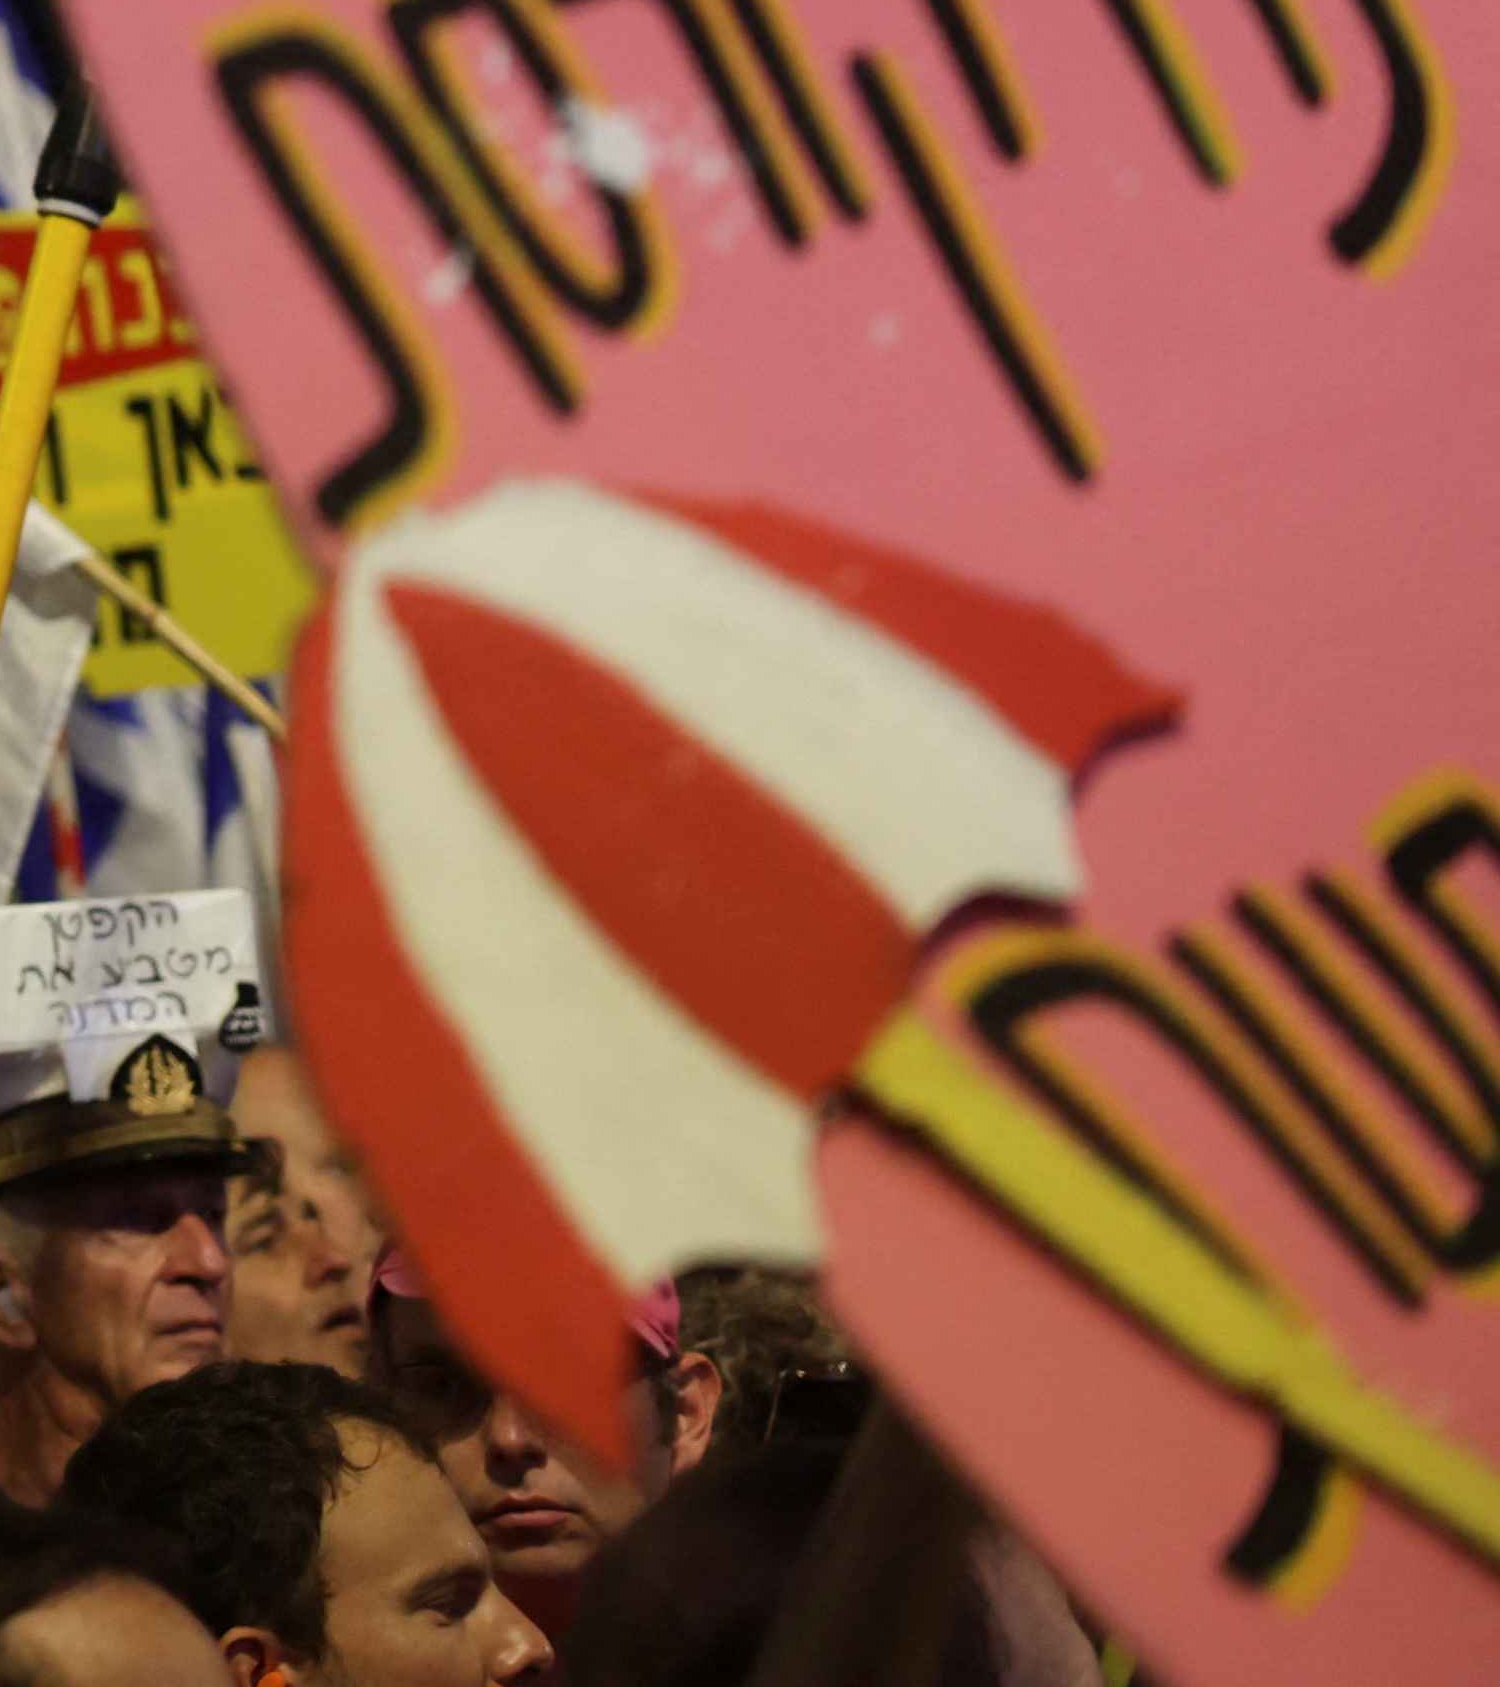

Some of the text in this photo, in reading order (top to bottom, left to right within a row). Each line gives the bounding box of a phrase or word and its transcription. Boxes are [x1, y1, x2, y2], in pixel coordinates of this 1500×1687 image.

[125, 391, 268, 522] אן
[16, 946, 232, 995] מטבע את
